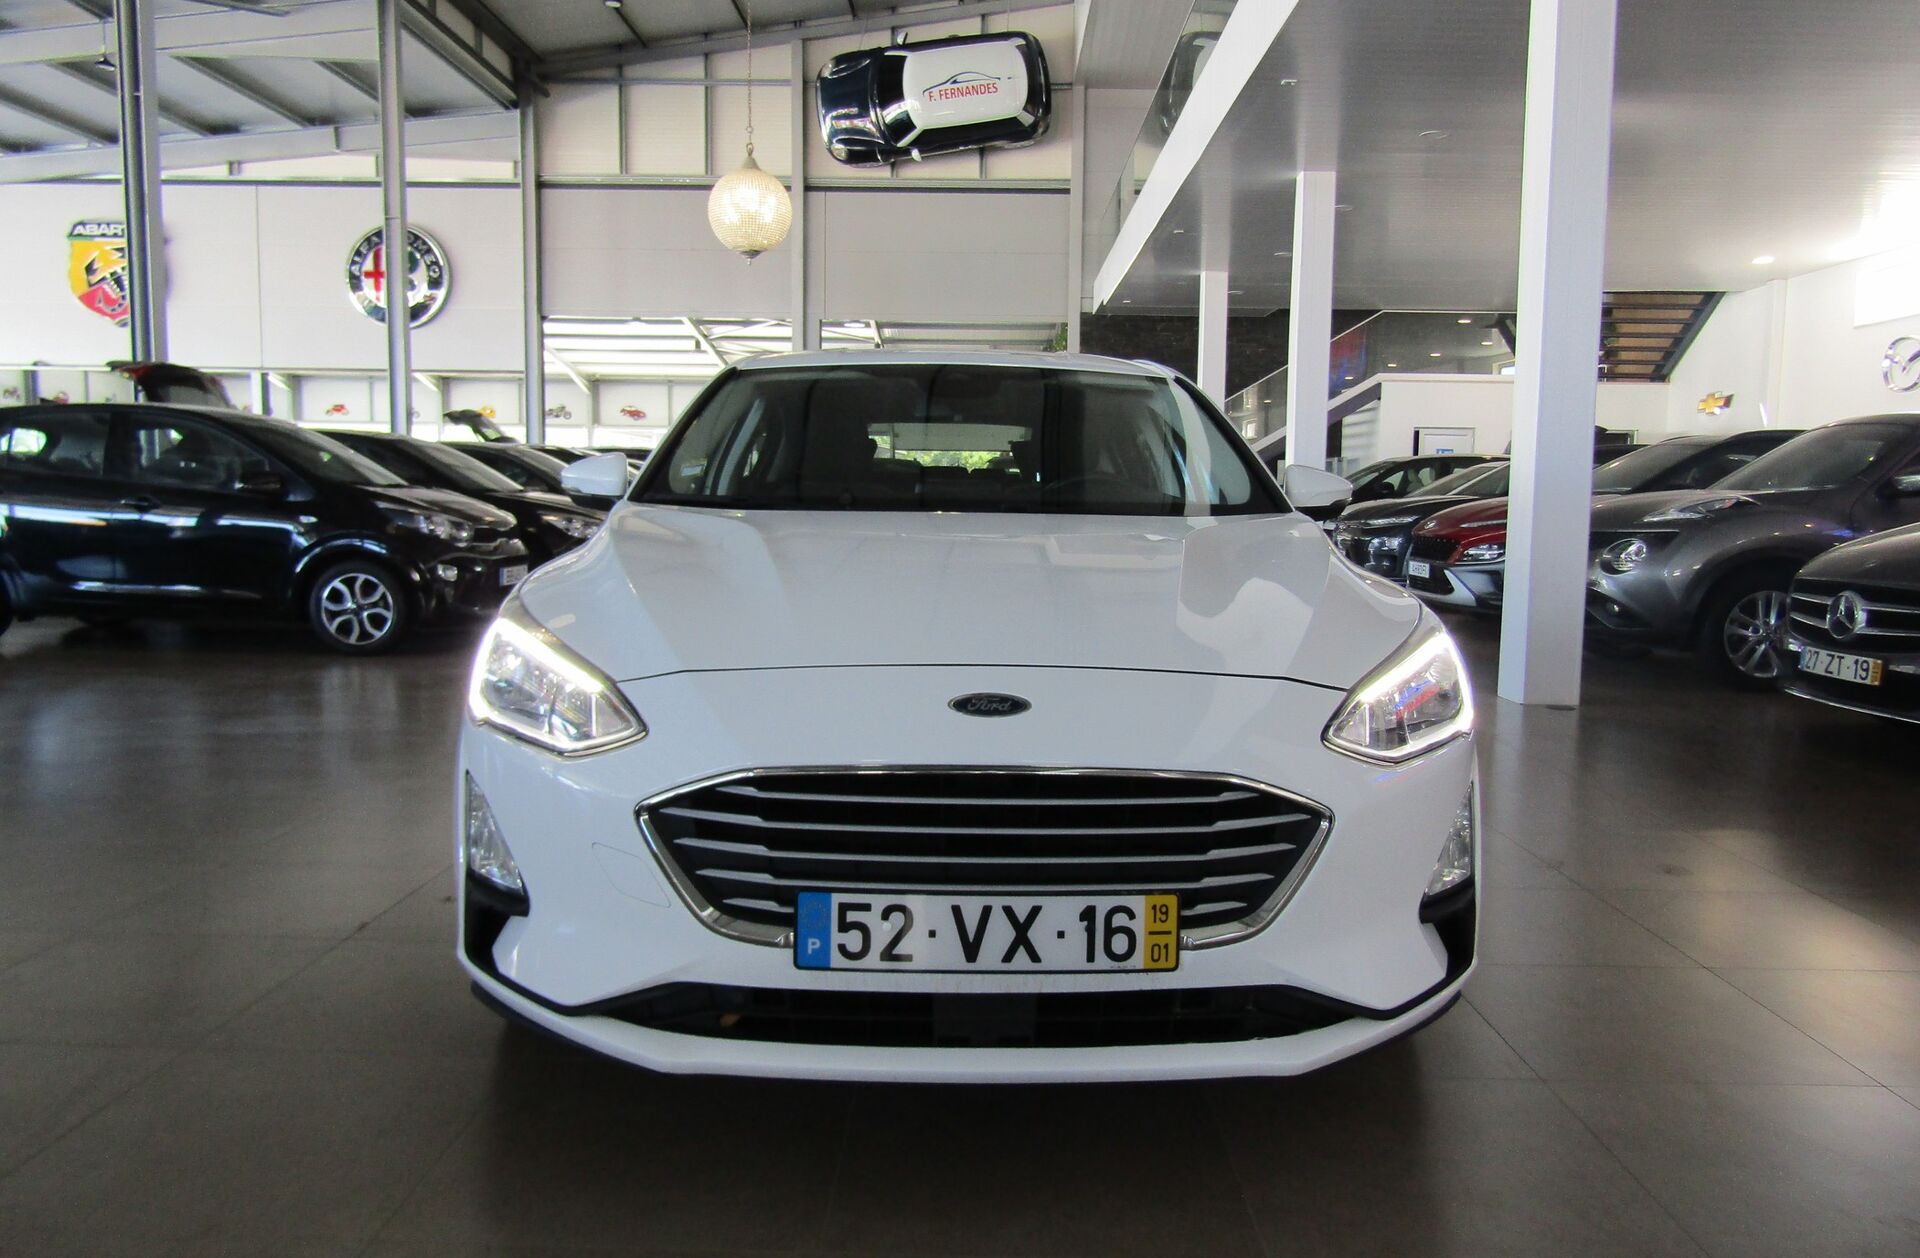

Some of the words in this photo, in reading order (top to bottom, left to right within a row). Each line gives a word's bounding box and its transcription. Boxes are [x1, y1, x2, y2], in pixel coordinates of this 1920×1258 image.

[928, 91, 937, 102] F.
[938, 82, 999, 100] FERNANDES
[72, 223, 126, 236] ABAR
[967, 696, 1012, 711] Ford
[1151, 903, 1169, 924] 19
[807, 938, 821, 955] P
[1150, 942, 1169, 963] 01
